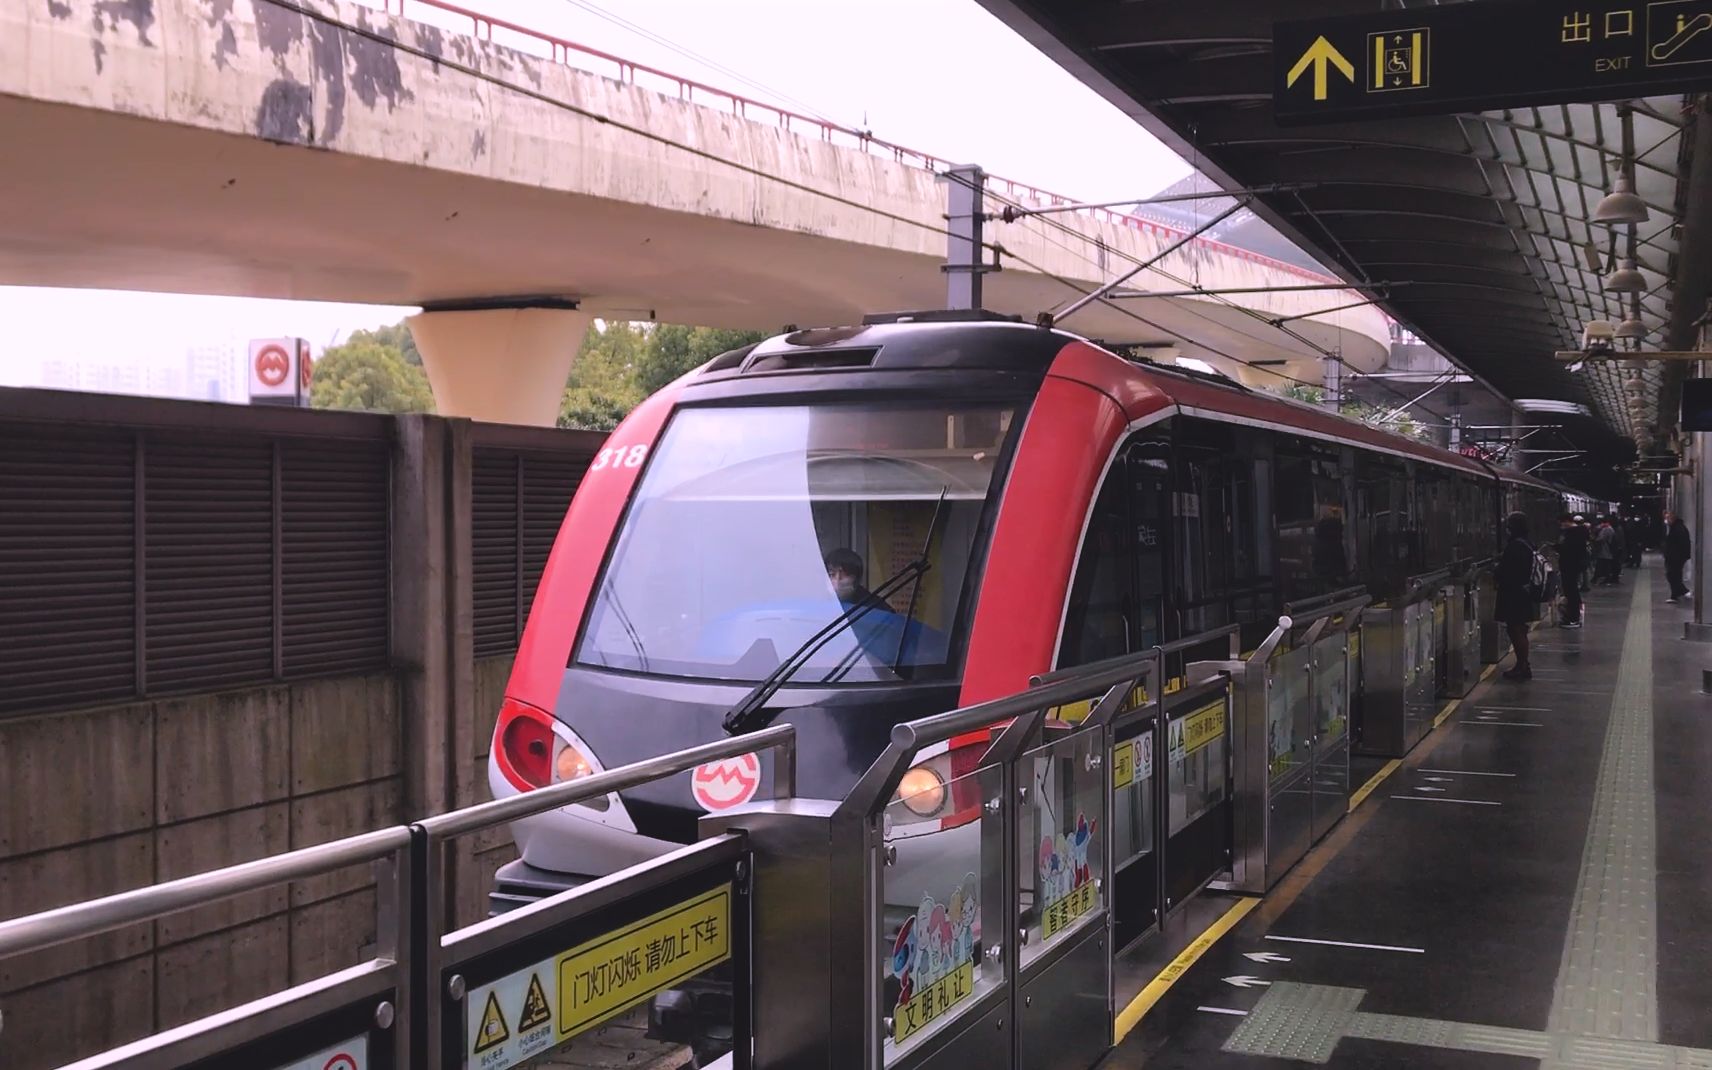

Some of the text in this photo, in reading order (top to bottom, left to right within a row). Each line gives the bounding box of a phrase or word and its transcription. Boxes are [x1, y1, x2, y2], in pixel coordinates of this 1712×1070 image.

[1562, 10, 1633, 43] 出口
[1595, 56, 1632, 72] EXIT
[591, 444, 648, 470] 318
[573, 915, 719, 1010] 门灯闪烁 请勿上下车
[904, 971, 966, 1035] 文明礼让
